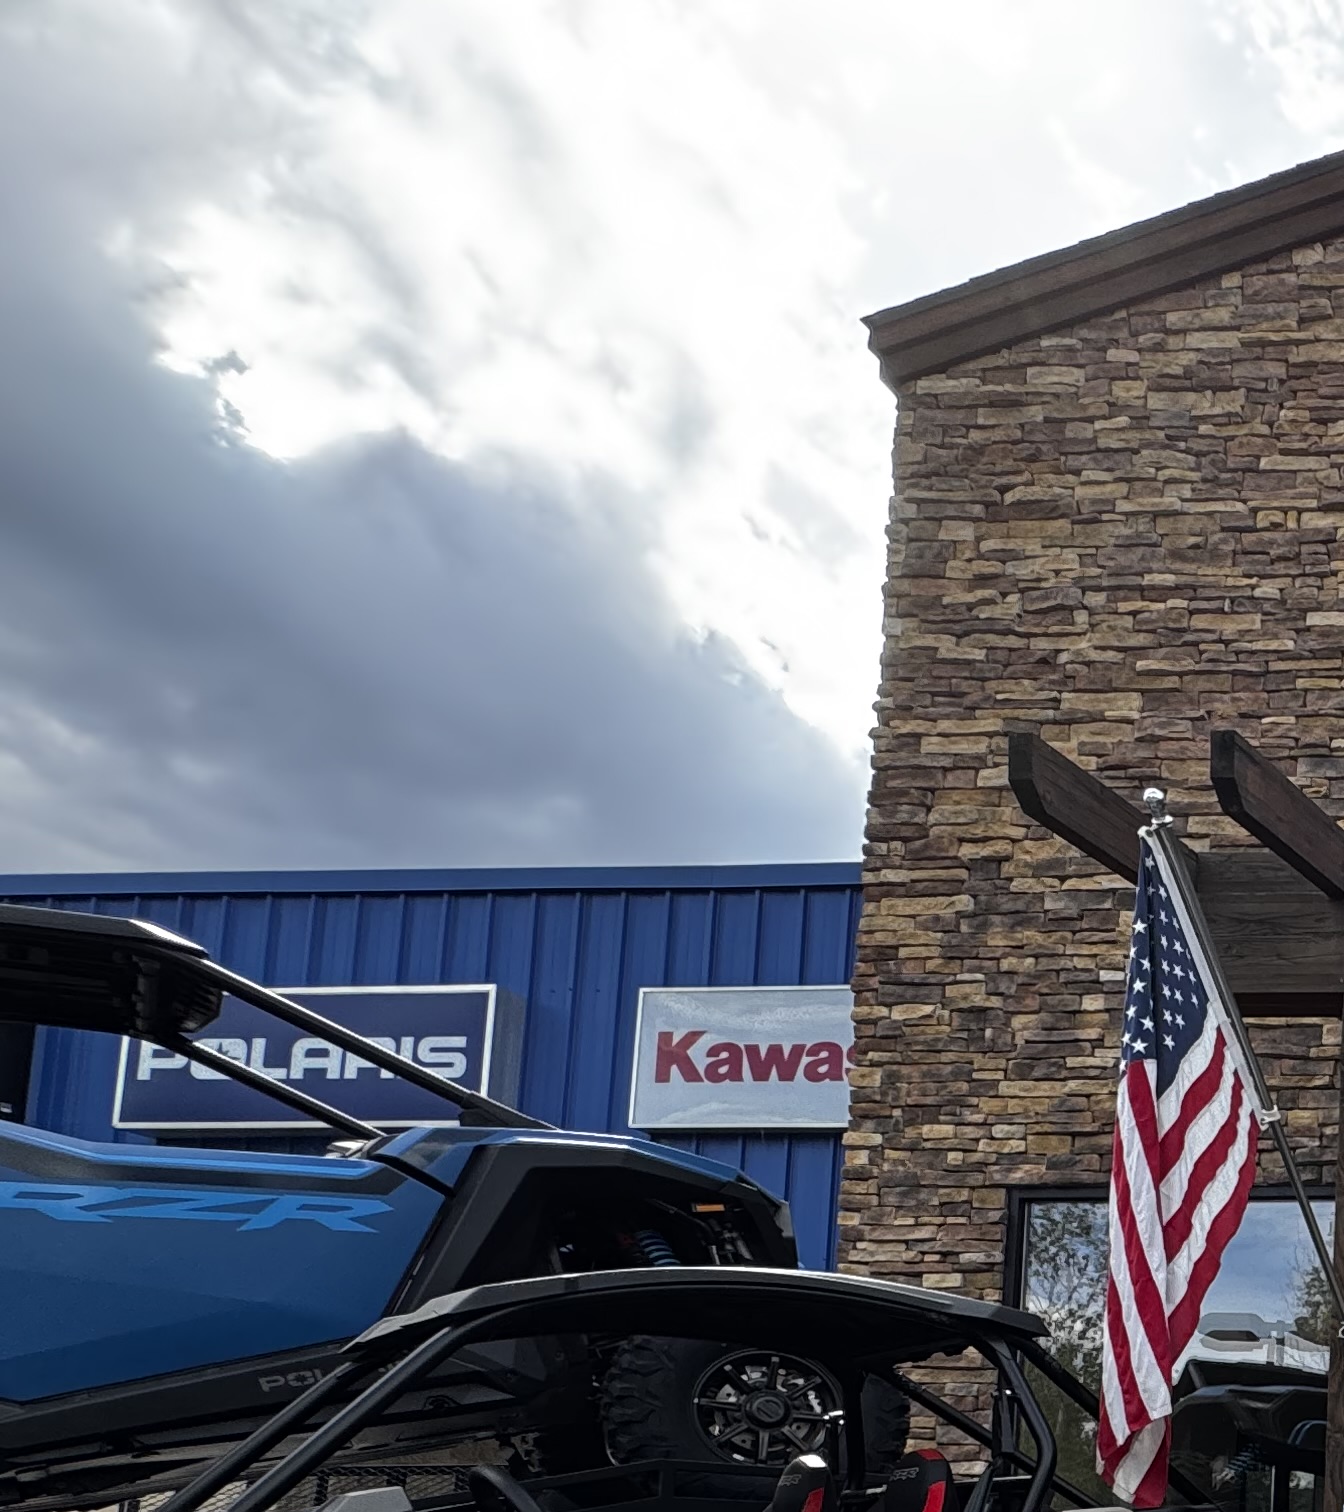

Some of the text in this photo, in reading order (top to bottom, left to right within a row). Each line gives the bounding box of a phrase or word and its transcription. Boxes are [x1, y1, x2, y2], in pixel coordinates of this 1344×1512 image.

[137, 1036, 467, 1081] POLARIS
[655, 1031, 856, 1083] Kawa
[0, 1181, 395, 1234] RZR
